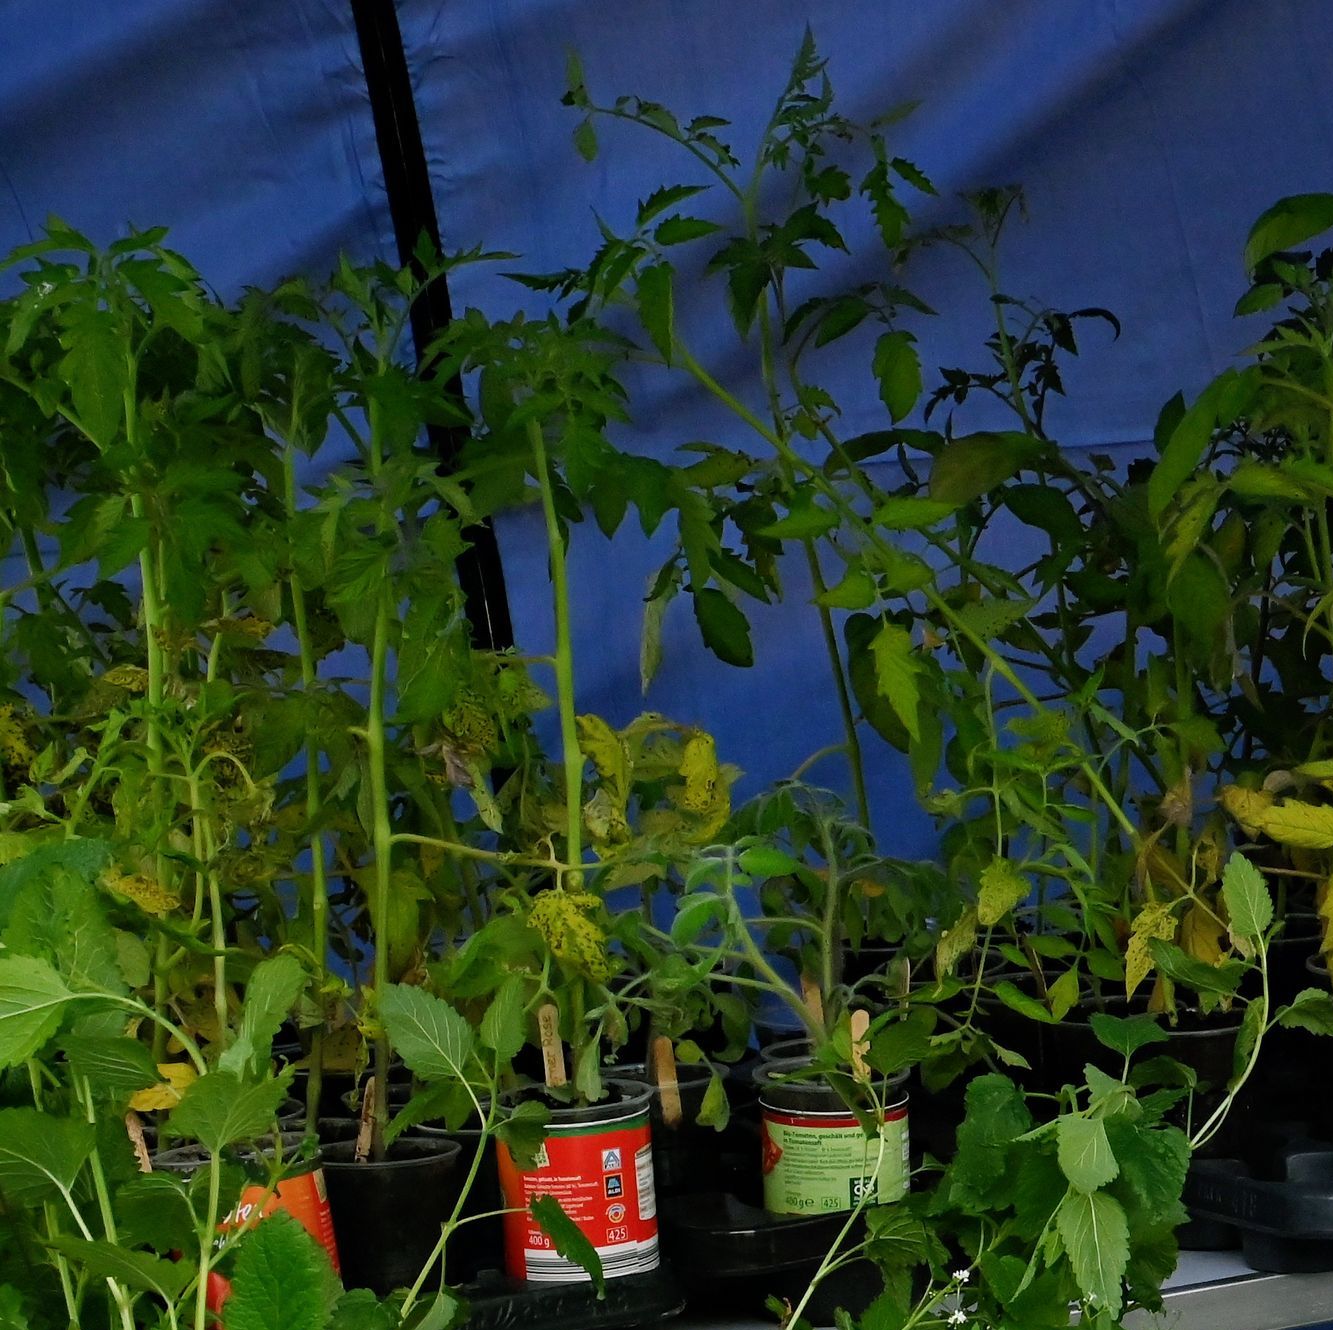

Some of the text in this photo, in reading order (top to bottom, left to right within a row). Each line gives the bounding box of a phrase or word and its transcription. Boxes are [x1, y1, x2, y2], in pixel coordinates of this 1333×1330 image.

[823, 1197, 839, 1208] 425
[608, 1227, 626, 1241] 425
[528, 1235, 550, 1249] 400 g
